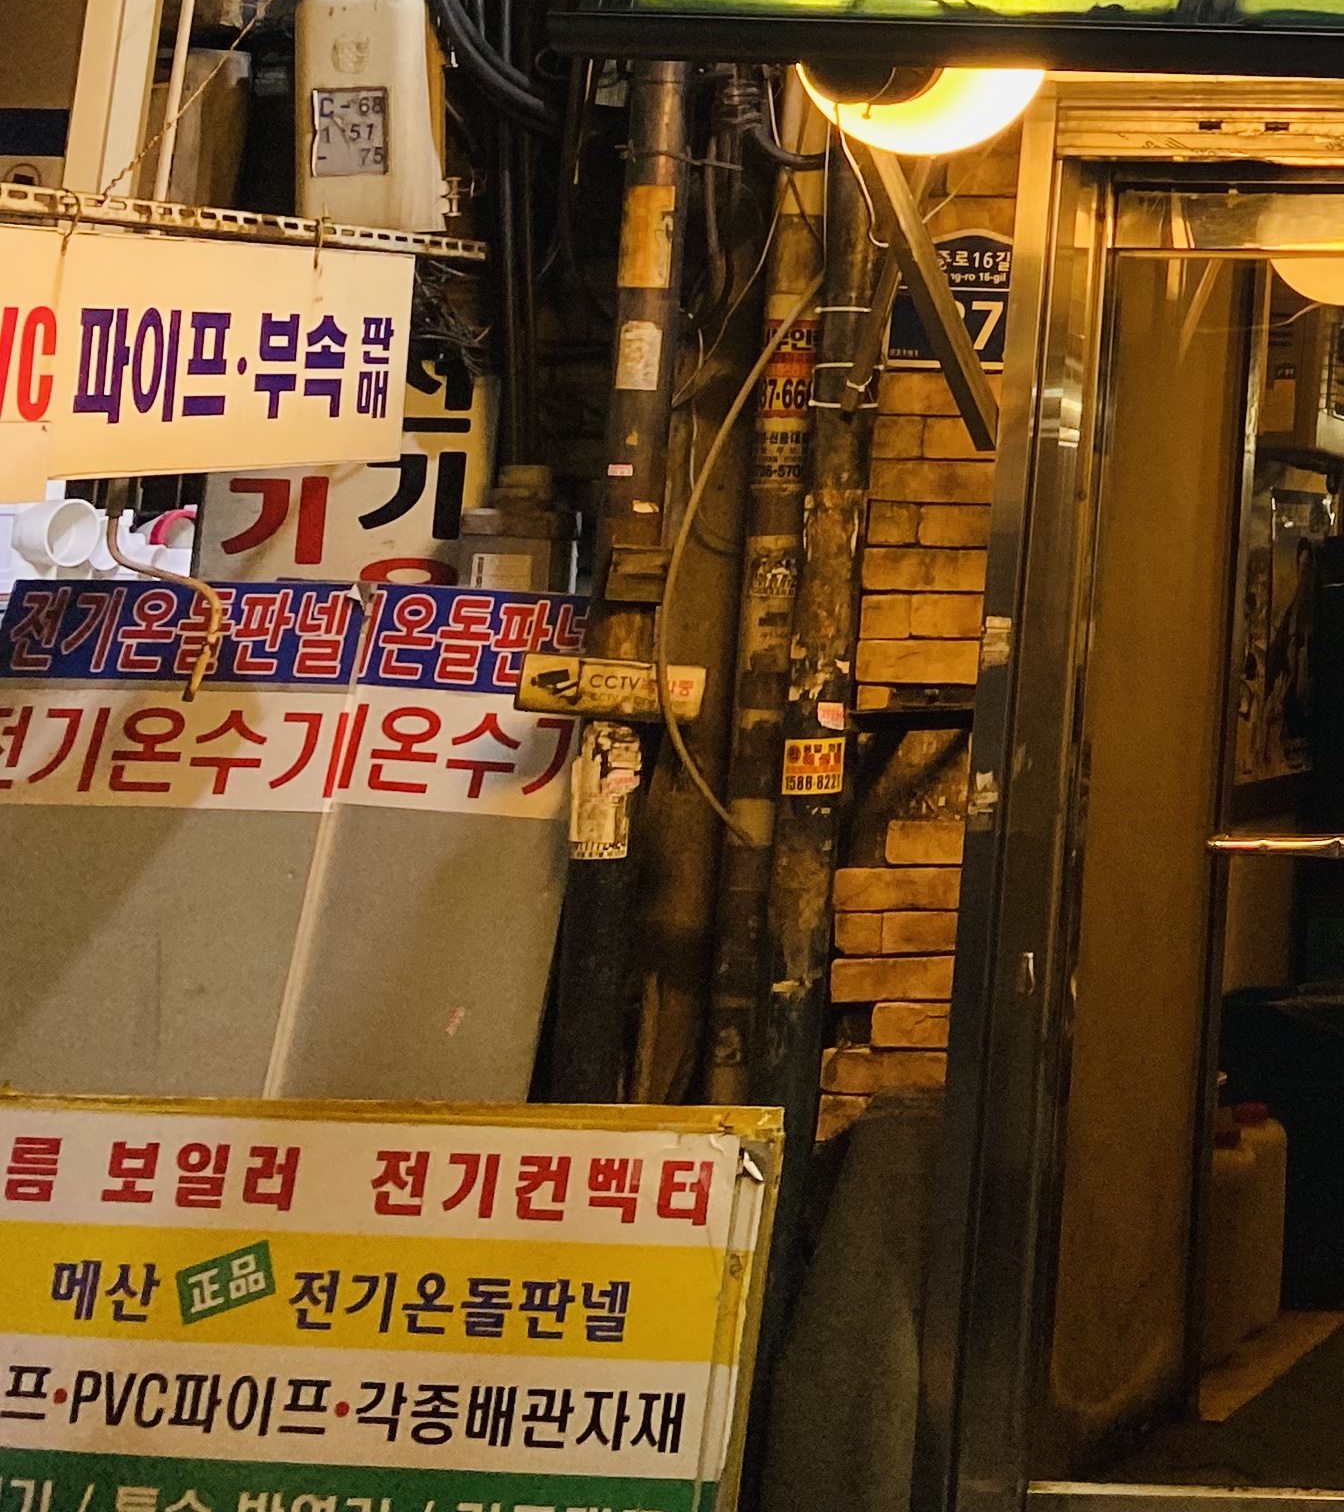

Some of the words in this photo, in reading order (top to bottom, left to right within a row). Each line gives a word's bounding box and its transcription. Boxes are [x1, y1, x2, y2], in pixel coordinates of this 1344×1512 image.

[356, 317, 395, 419] 판매
[100, 1141, 301, 1212] 보일러
[370, 1149, 716, 1228] 전기컨벡터
[289, 1268, 632, 1344] 전기온돌판넬
